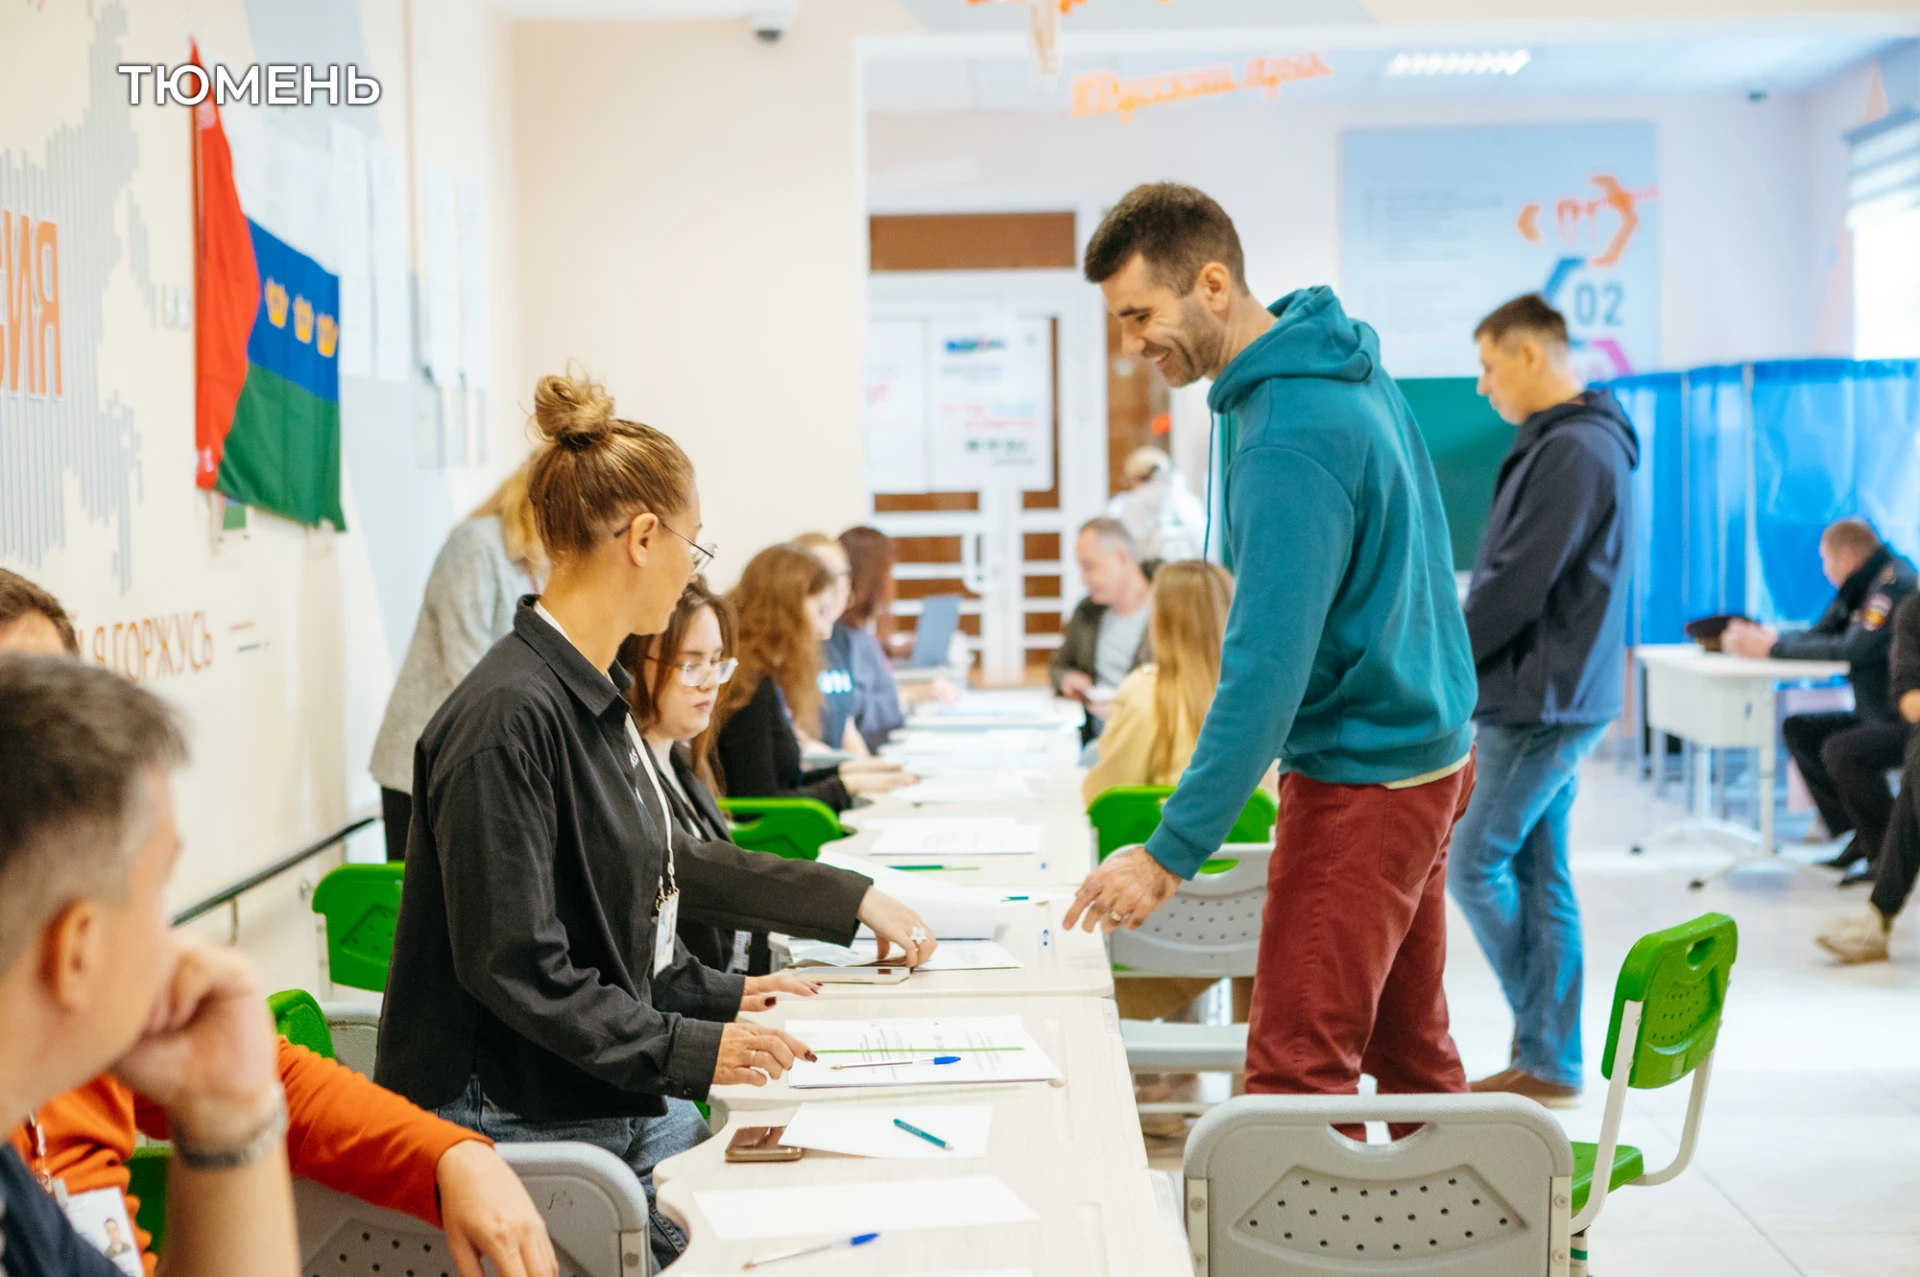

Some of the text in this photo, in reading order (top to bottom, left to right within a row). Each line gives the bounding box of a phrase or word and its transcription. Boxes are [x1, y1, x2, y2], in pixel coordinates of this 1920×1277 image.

[0, 210, 63, 398] ИЯ
[1575, 282, 1625, 327] 02
[113, 610, 214, 686] ГОРЖУСЬ
